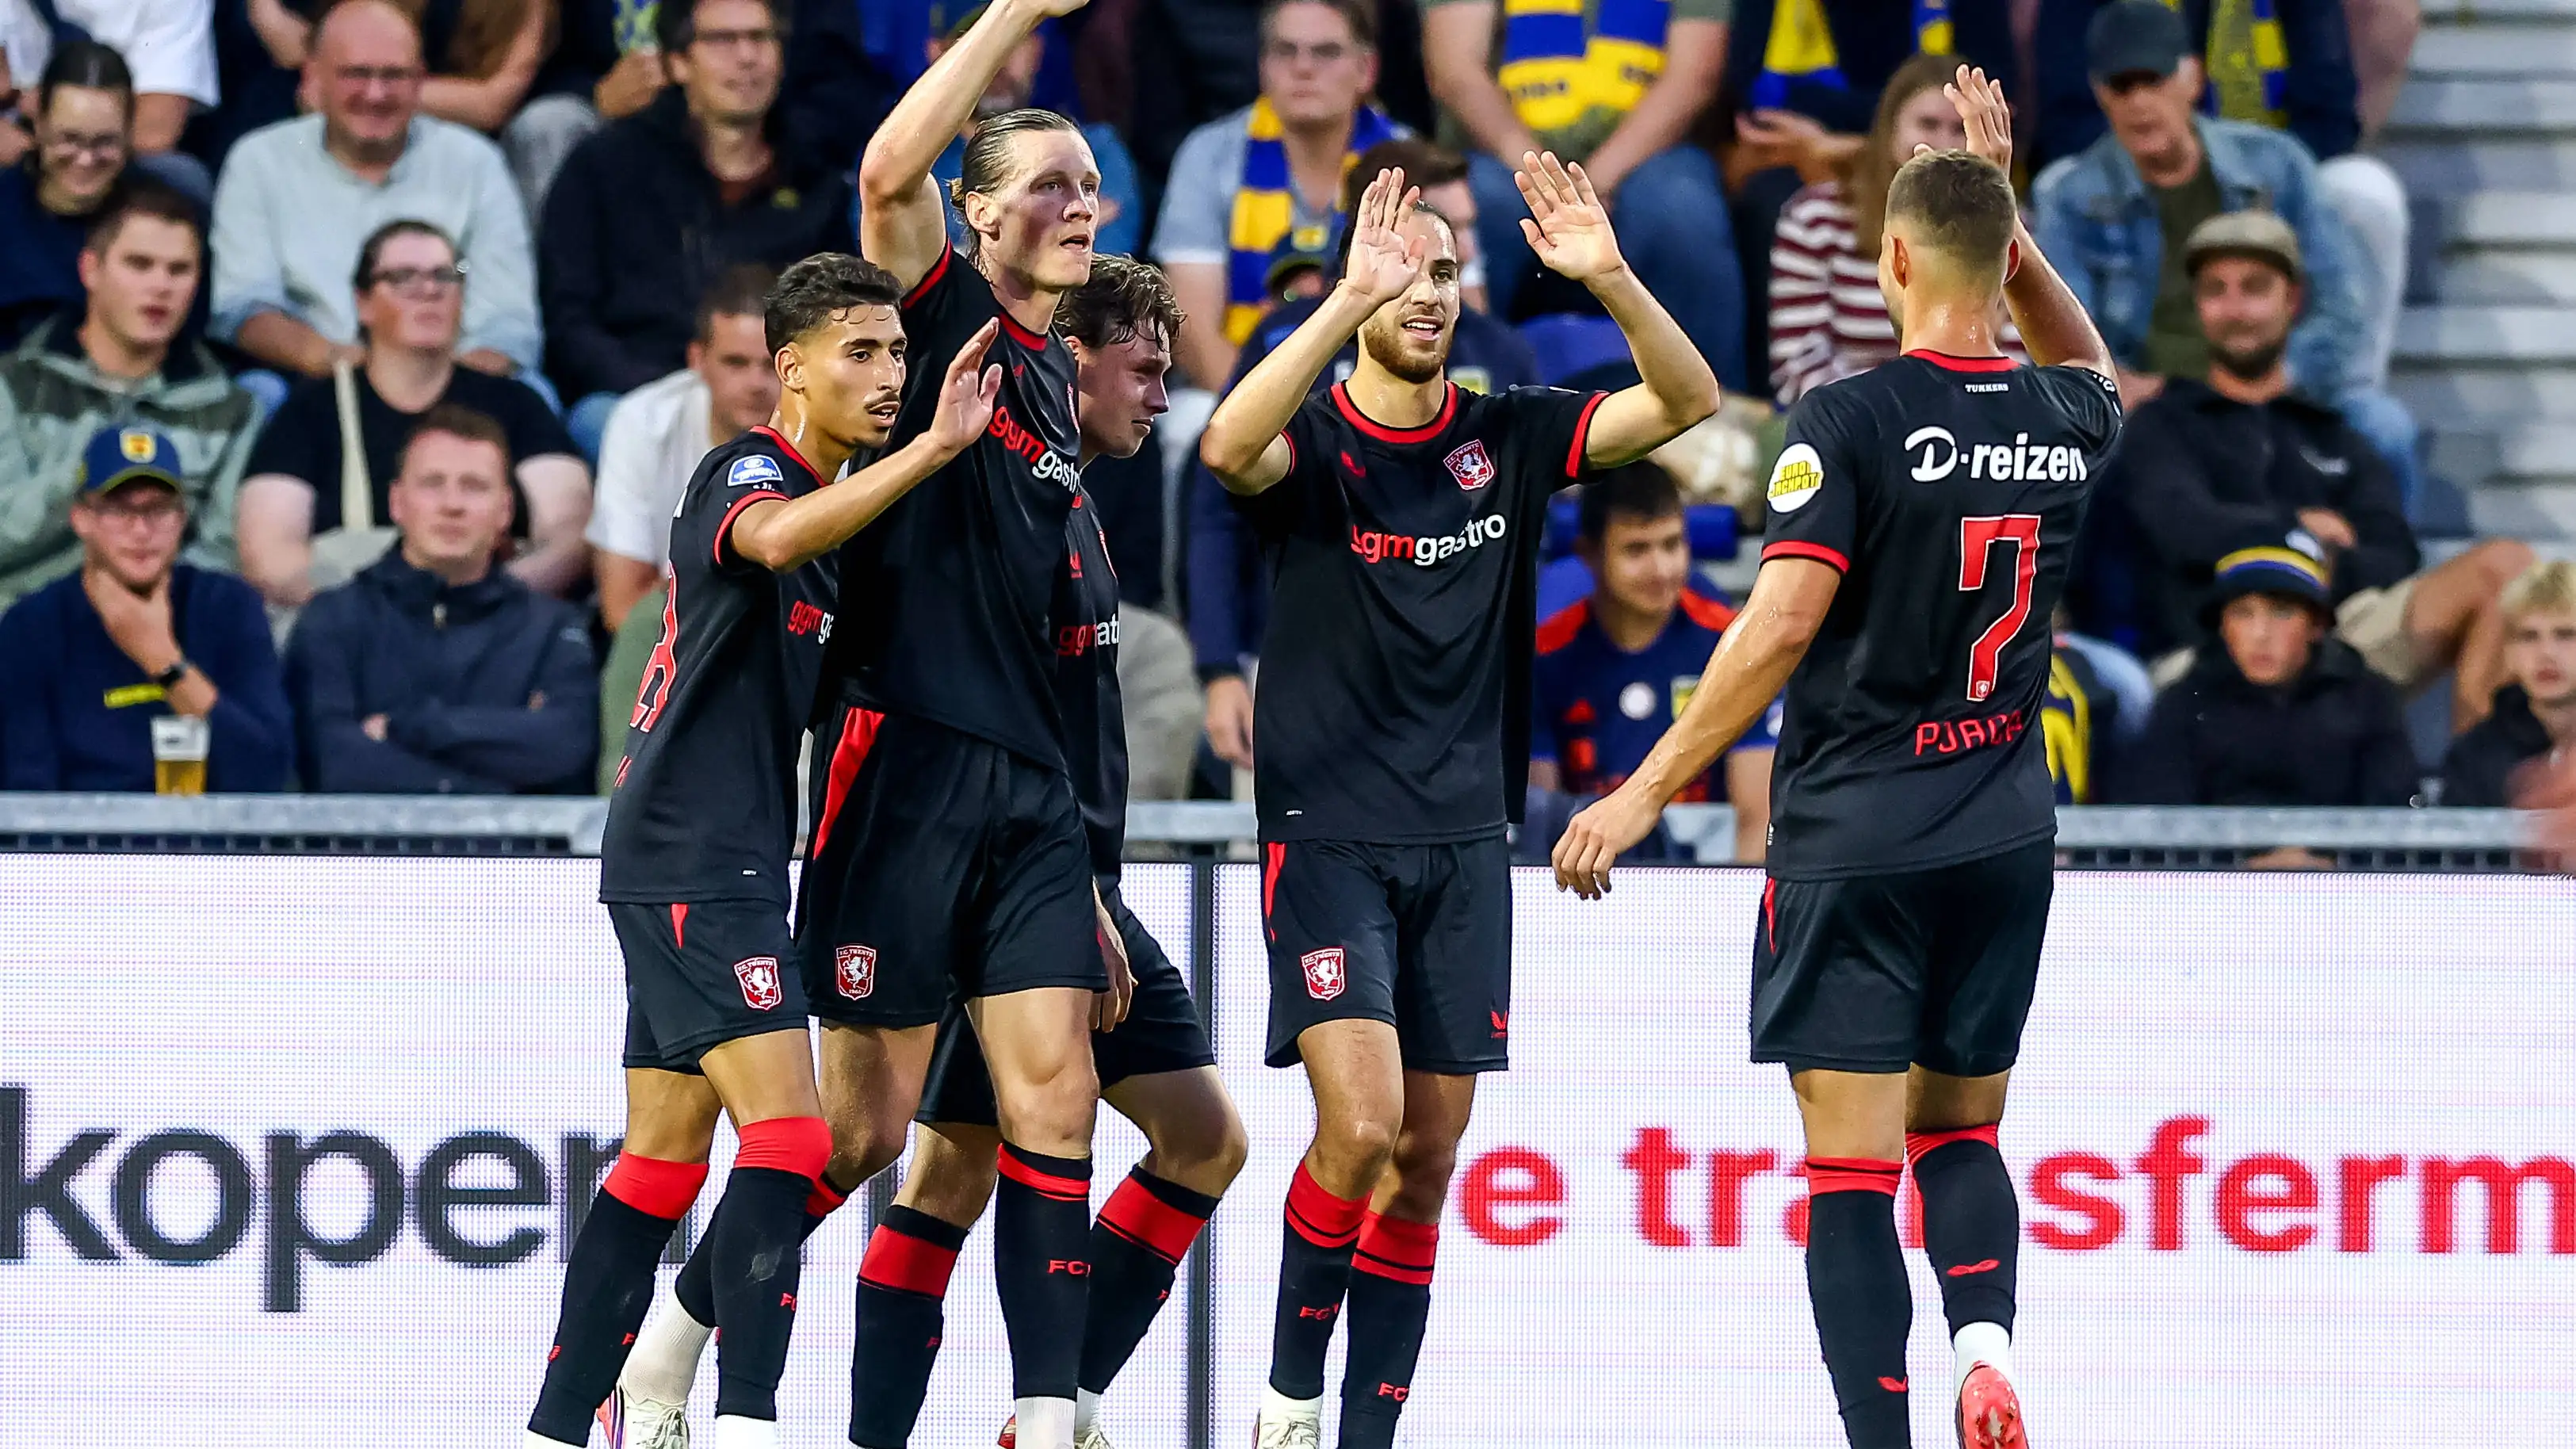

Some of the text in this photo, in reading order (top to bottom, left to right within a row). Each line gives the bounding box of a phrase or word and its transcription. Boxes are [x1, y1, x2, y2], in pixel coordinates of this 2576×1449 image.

[1959, 514, 2042, 702] 7
[1457, 1114, 2576, 1255] e trsferm
